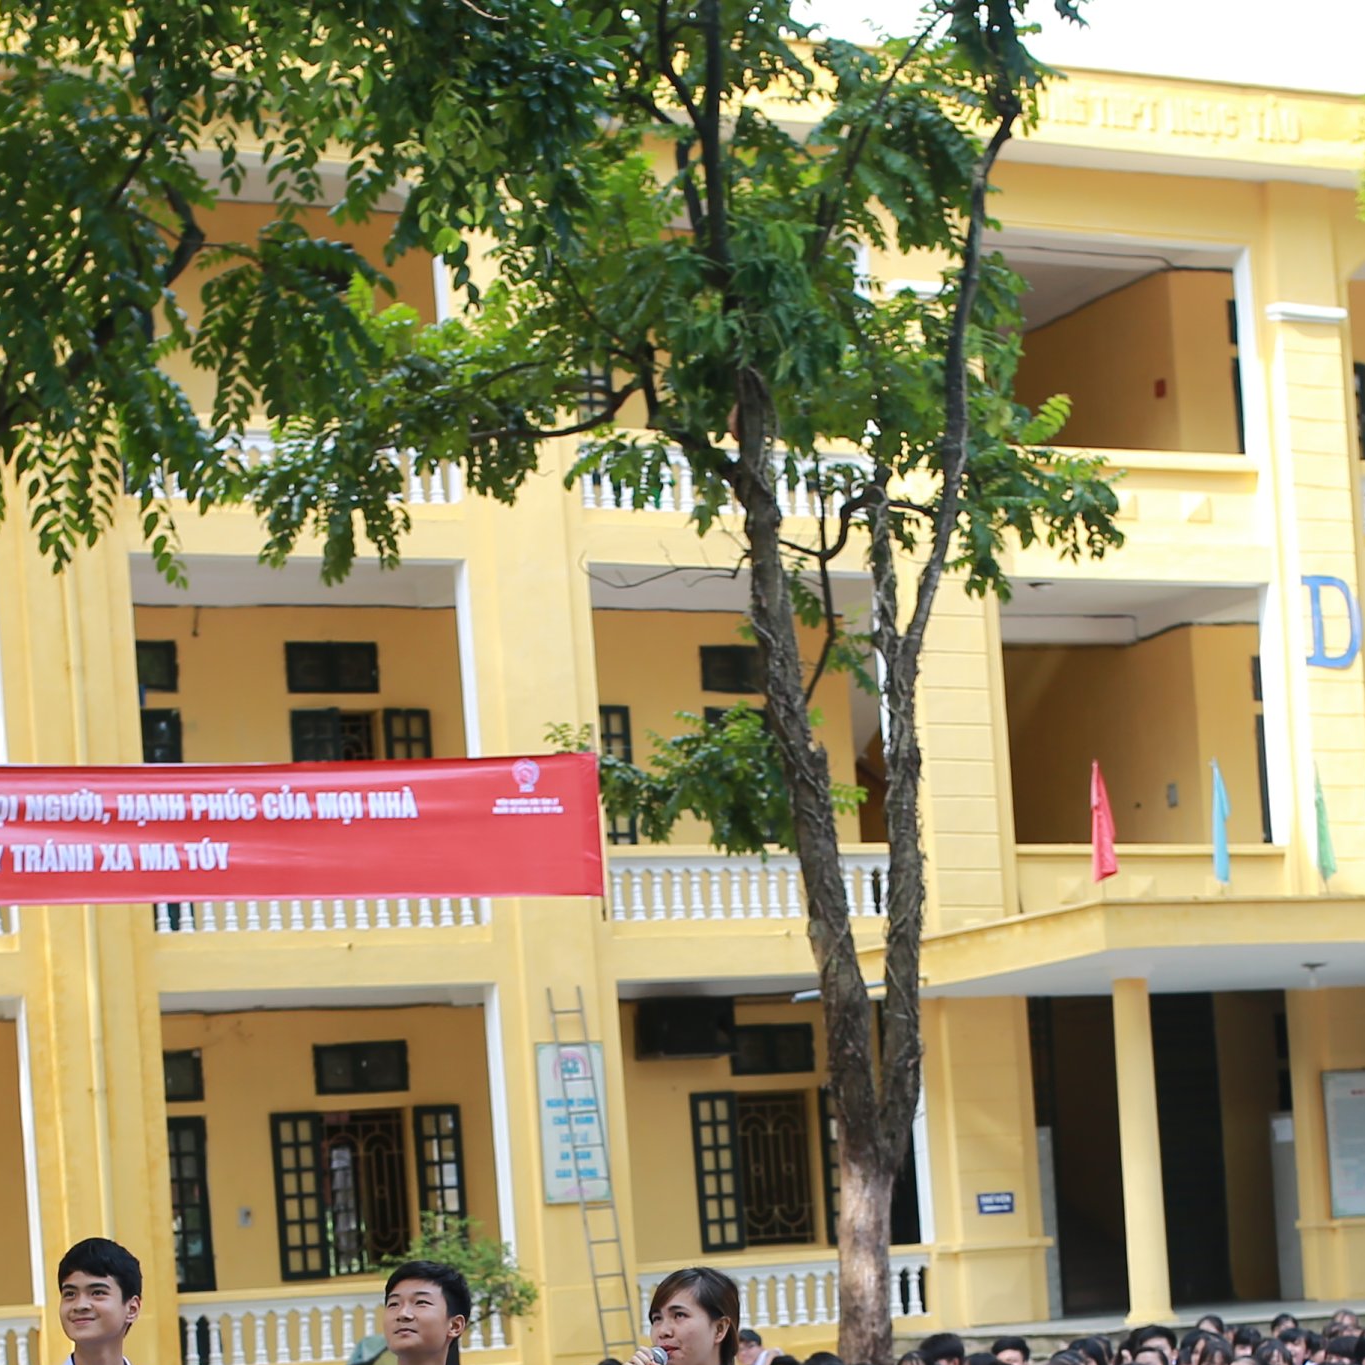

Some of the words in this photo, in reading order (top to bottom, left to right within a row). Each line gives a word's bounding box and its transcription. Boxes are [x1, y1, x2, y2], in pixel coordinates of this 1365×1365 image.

[1300, 575, 1363, 670] D
[24, 787, 111, 825] NGƯỜI,
[117, 793, 185, 826] HẠNH
[191, 787, 257, 821] PHÚC
[262, 784, 312, 821] CỦA
[315, 791, 364, 825] MỌI
[367, 786, 419, 819] NHÀ
[10, 838, 94, 873] TRÁNH
[99, 843, 134, 872] XA
[139, 842, 181, 871] MA
[183, 837, 230, 870] TÚY
